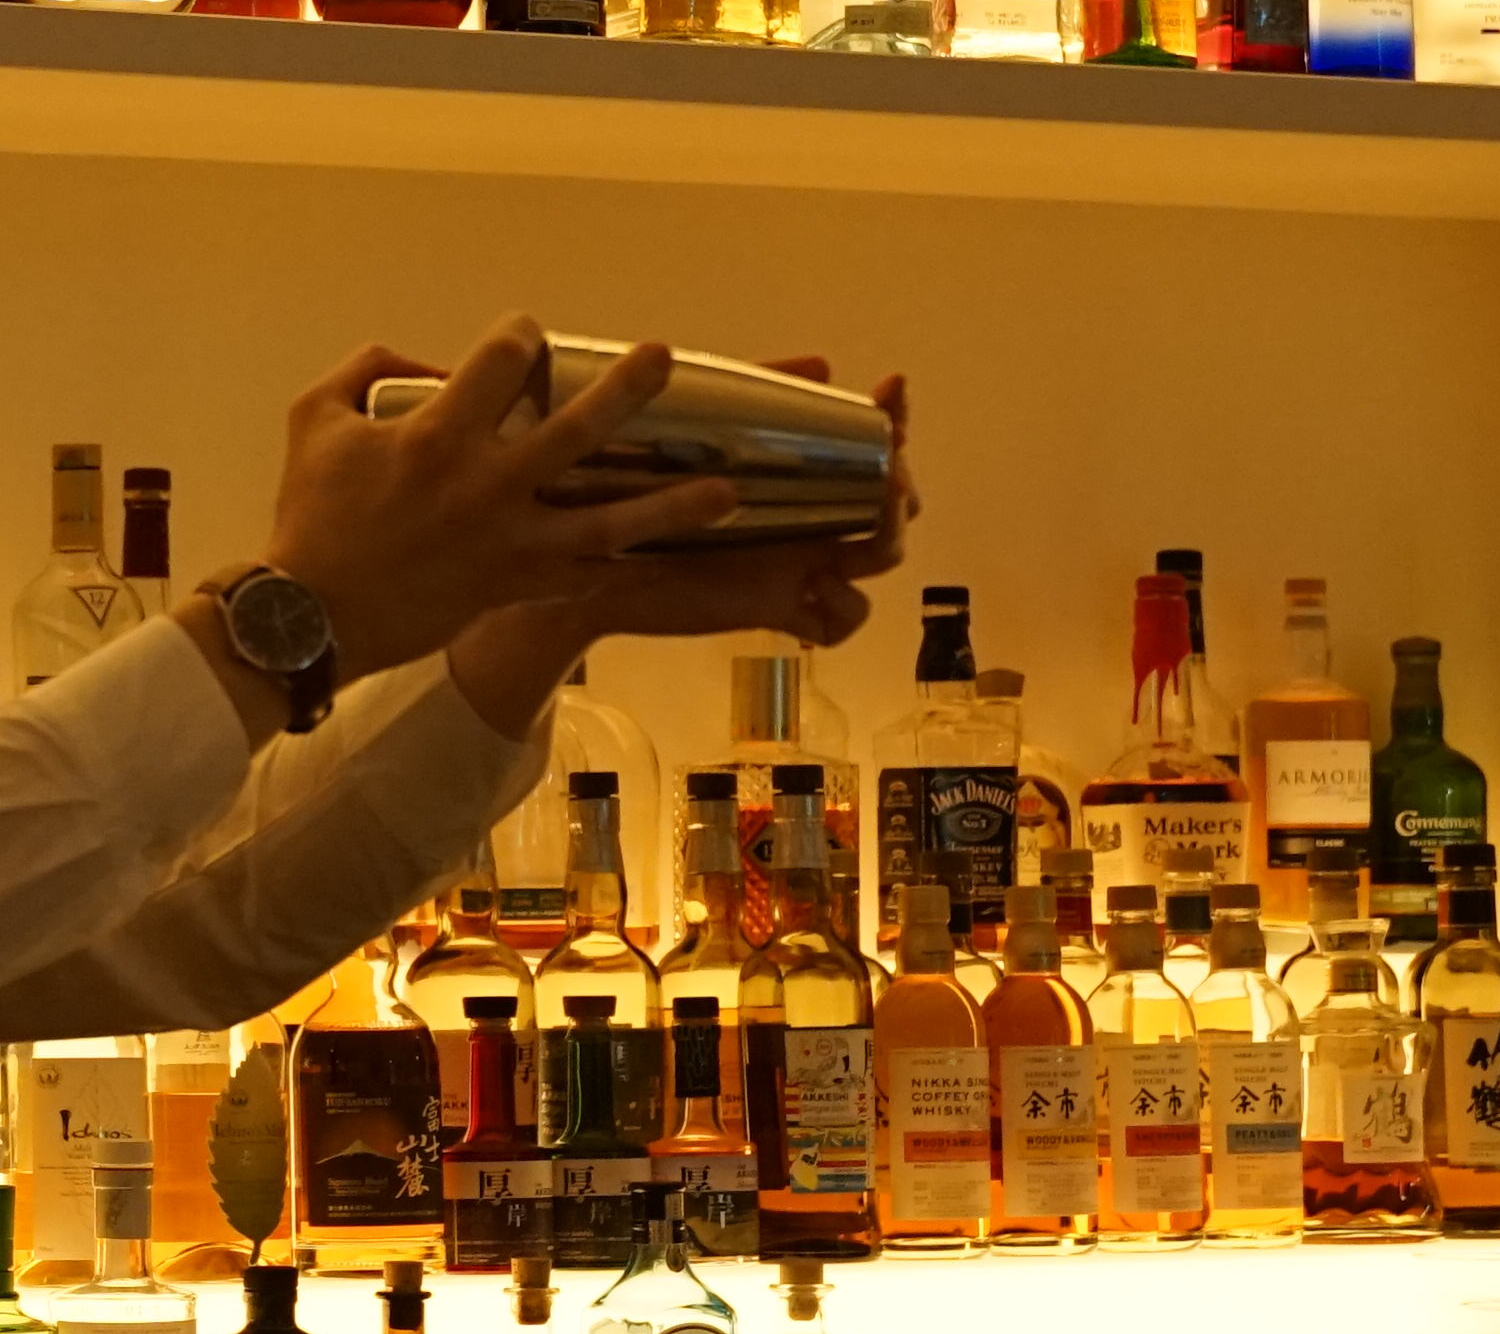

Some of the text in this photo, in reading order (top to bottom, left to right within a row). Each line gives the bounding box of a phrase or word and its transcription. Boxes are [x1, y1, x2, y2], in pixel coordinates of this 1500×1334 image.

[931, 785, 964, 816] JACK
[1143, 816, 1244, 837] Maker's
[911, 1076, 960, 1088] NIKKA
[911, 1092, 969, 1103] COFFEY
[1020, 1086, 1079, 1121] 余市
[1129, 1084, 1186, 1118] 余市
[1230, 1082, 1287, 1115] 余市
[911, 1106, 972, 1117] WHISKY
